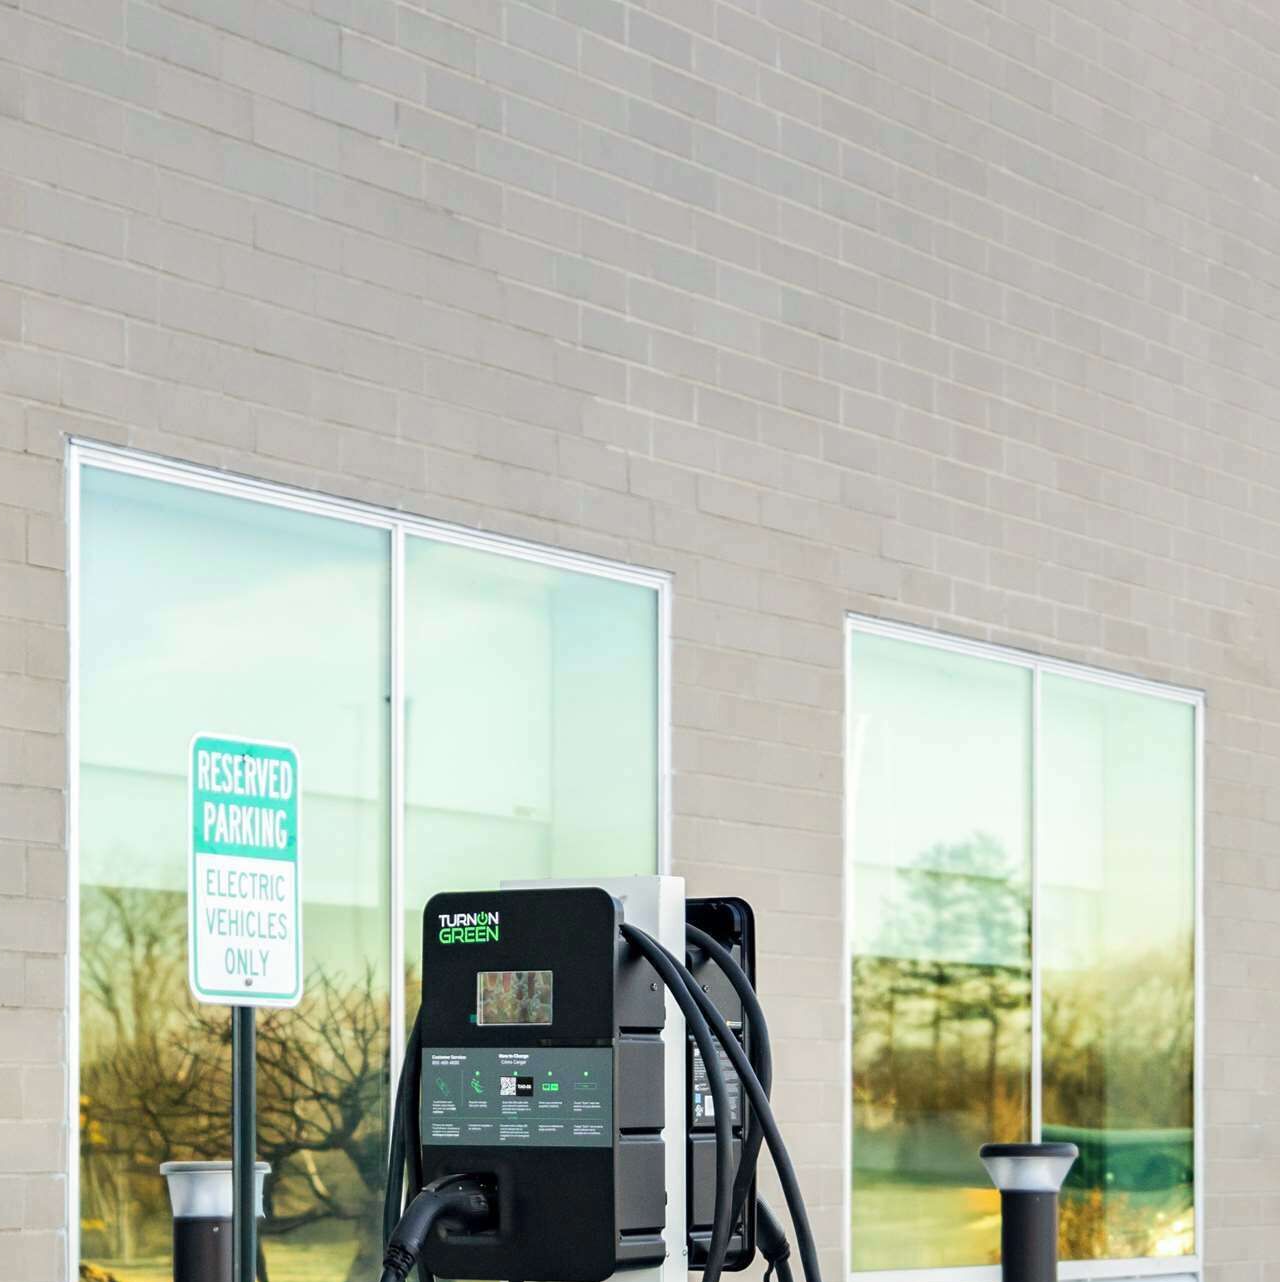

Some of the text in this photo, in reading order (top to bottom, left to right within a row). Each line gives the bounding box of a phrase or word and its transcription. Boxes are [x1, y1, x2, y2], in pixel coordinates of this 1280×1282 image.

[198, 750, 292, 800] RESERVED
[203, 801, 288, 849] PARKING
[206, 868, 285, 902] ELECTRIC
[206, 908, 288, 940] VEHICLES
[438, 911, 499, 928] TURNON
[439, 926, 499, 944] GREEN
[224, 947, 270, 977] ONLY
